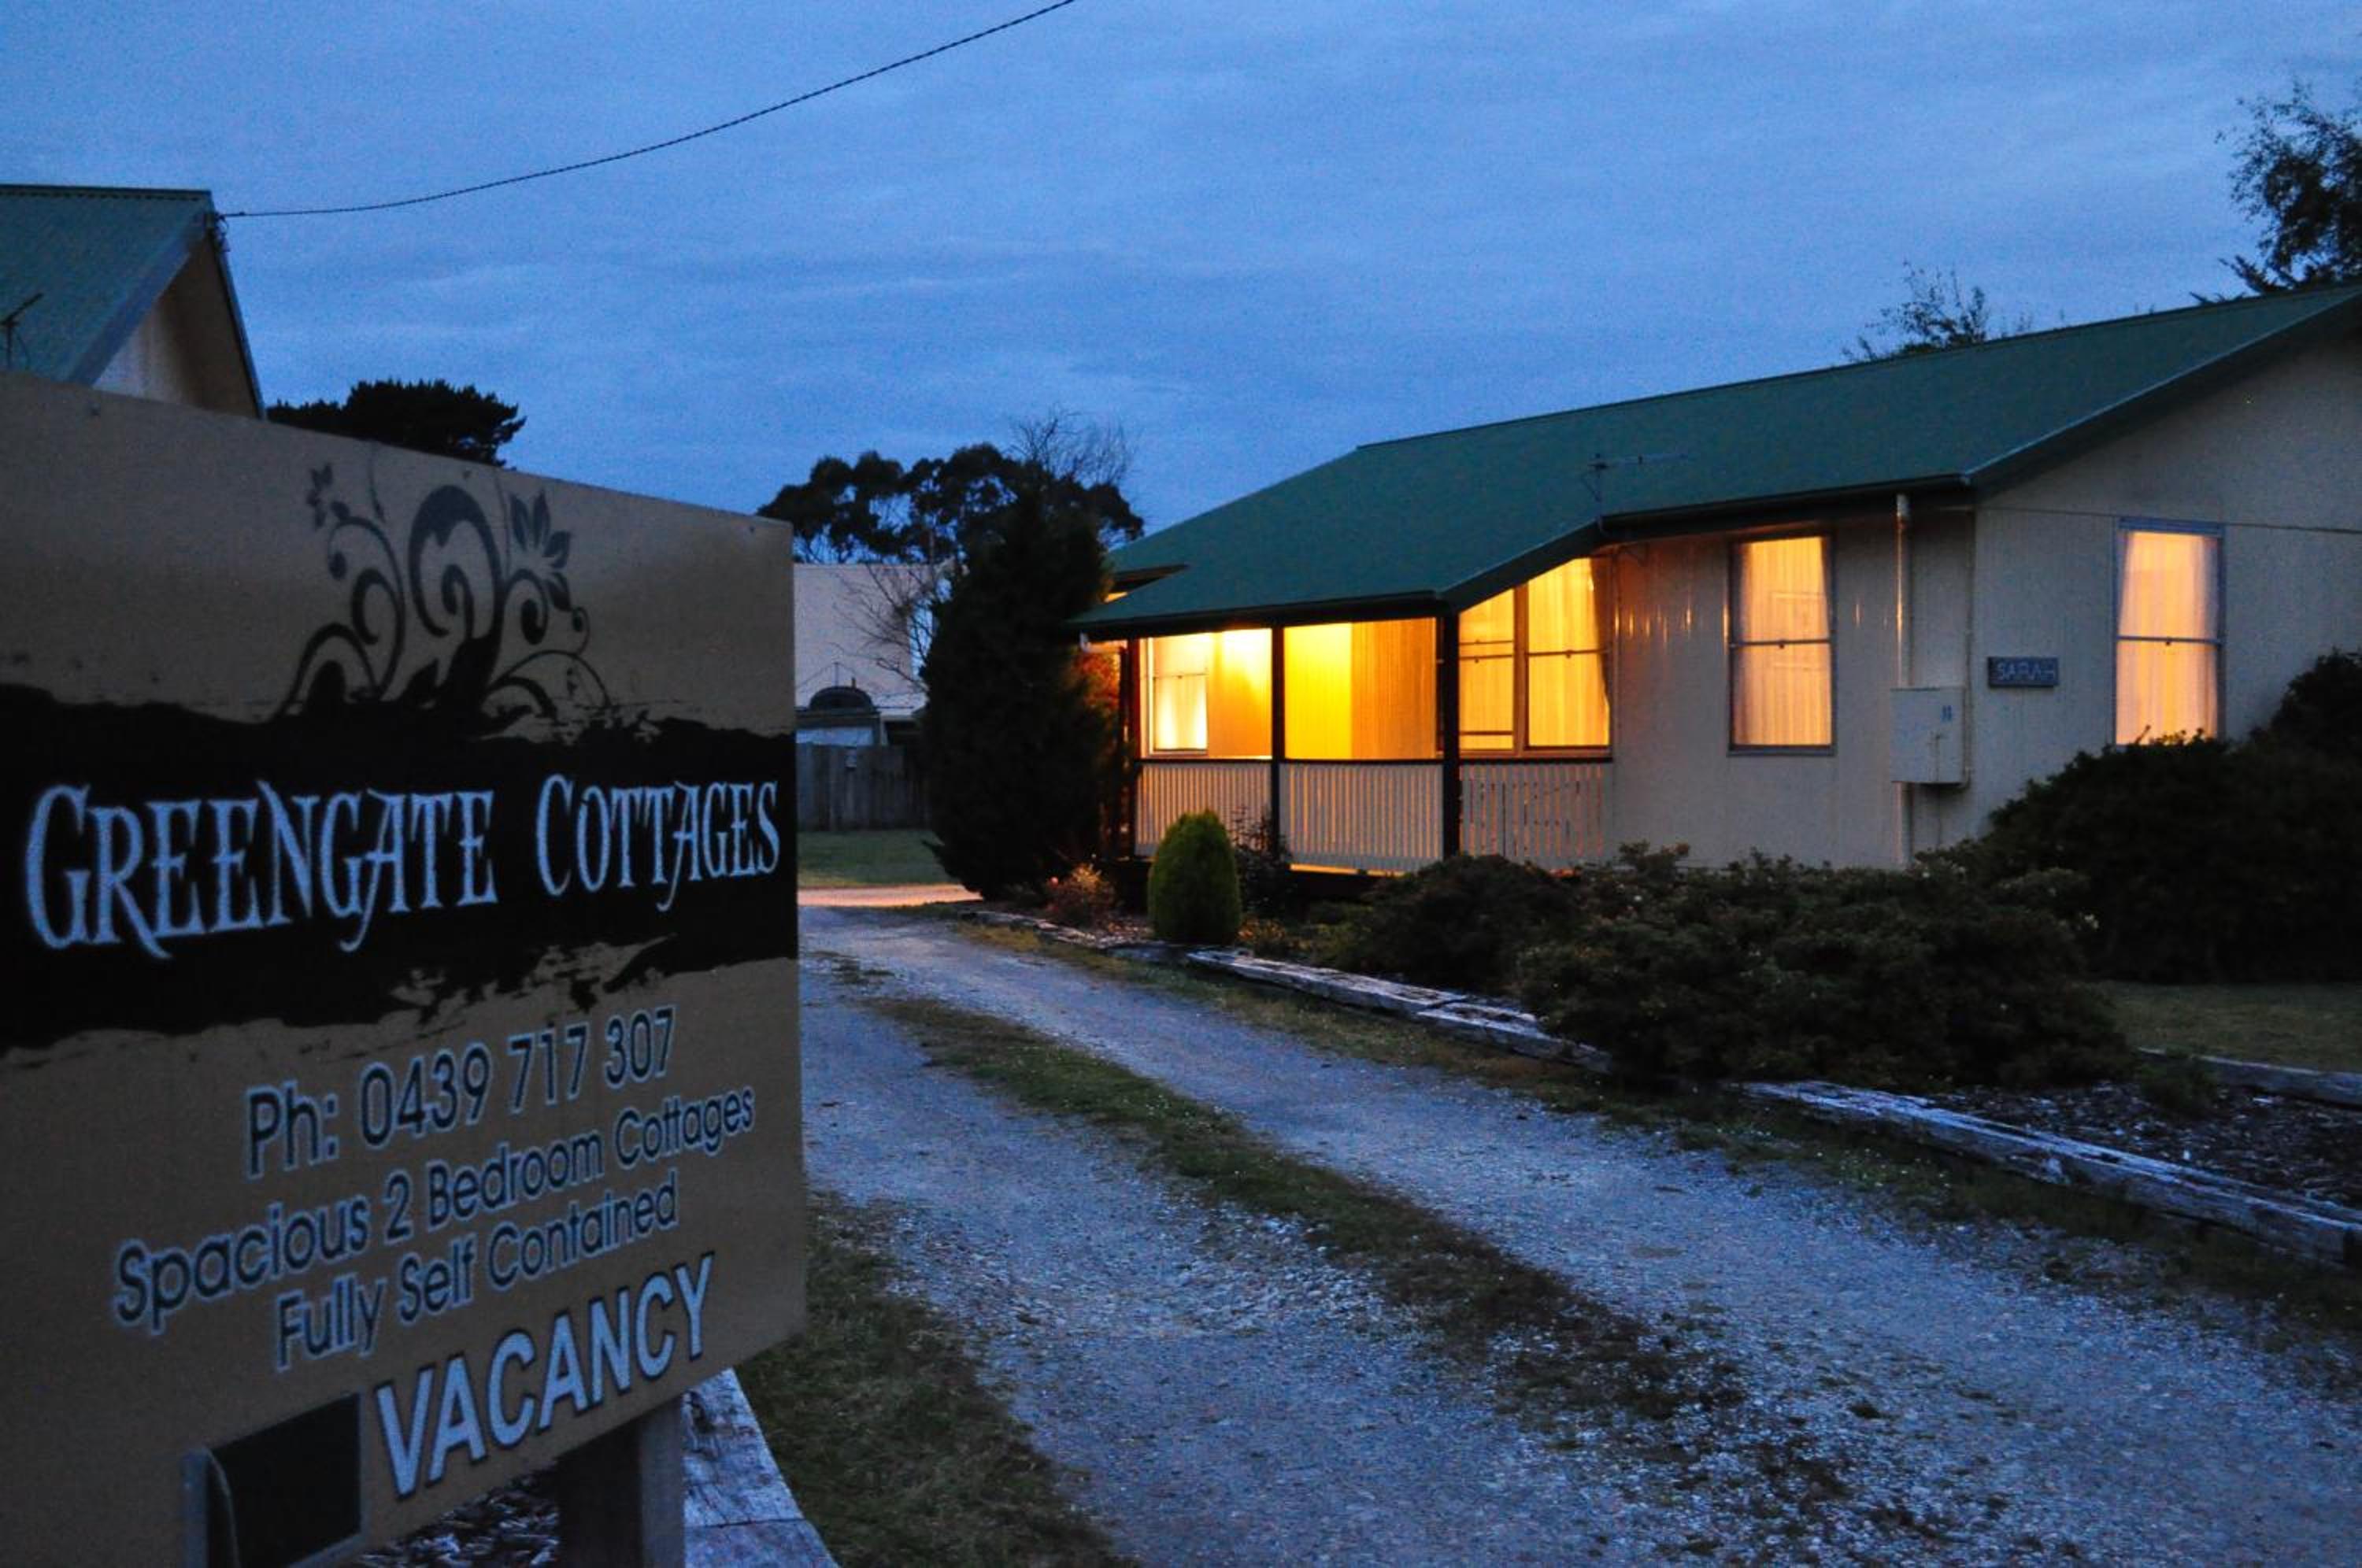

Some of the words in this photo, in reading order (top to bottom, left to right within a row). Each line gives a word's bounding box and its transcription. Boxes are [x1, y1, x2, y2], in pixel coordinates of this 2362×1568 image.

[245, 1078, 339, 1179] Ph:
[359, 1043, 493, 1148] 0439
[507, 1023, 590, 1115] 717
[604, 1005, 677, 1088] 307
[113, 1193, 372, 1337] Spacious
[384, 1171, 414, 1246] 2
[428, 1127, 604, 1232] Bedroom
[614, 1086, 756, 1169] Cottages
[276, 1274, 387, 1372] Fully
[396, 1238, 475, 1326] Self
[487, 1169, 680, 1291] Contained
[374, 1252, 716, 1502] VACANCY
